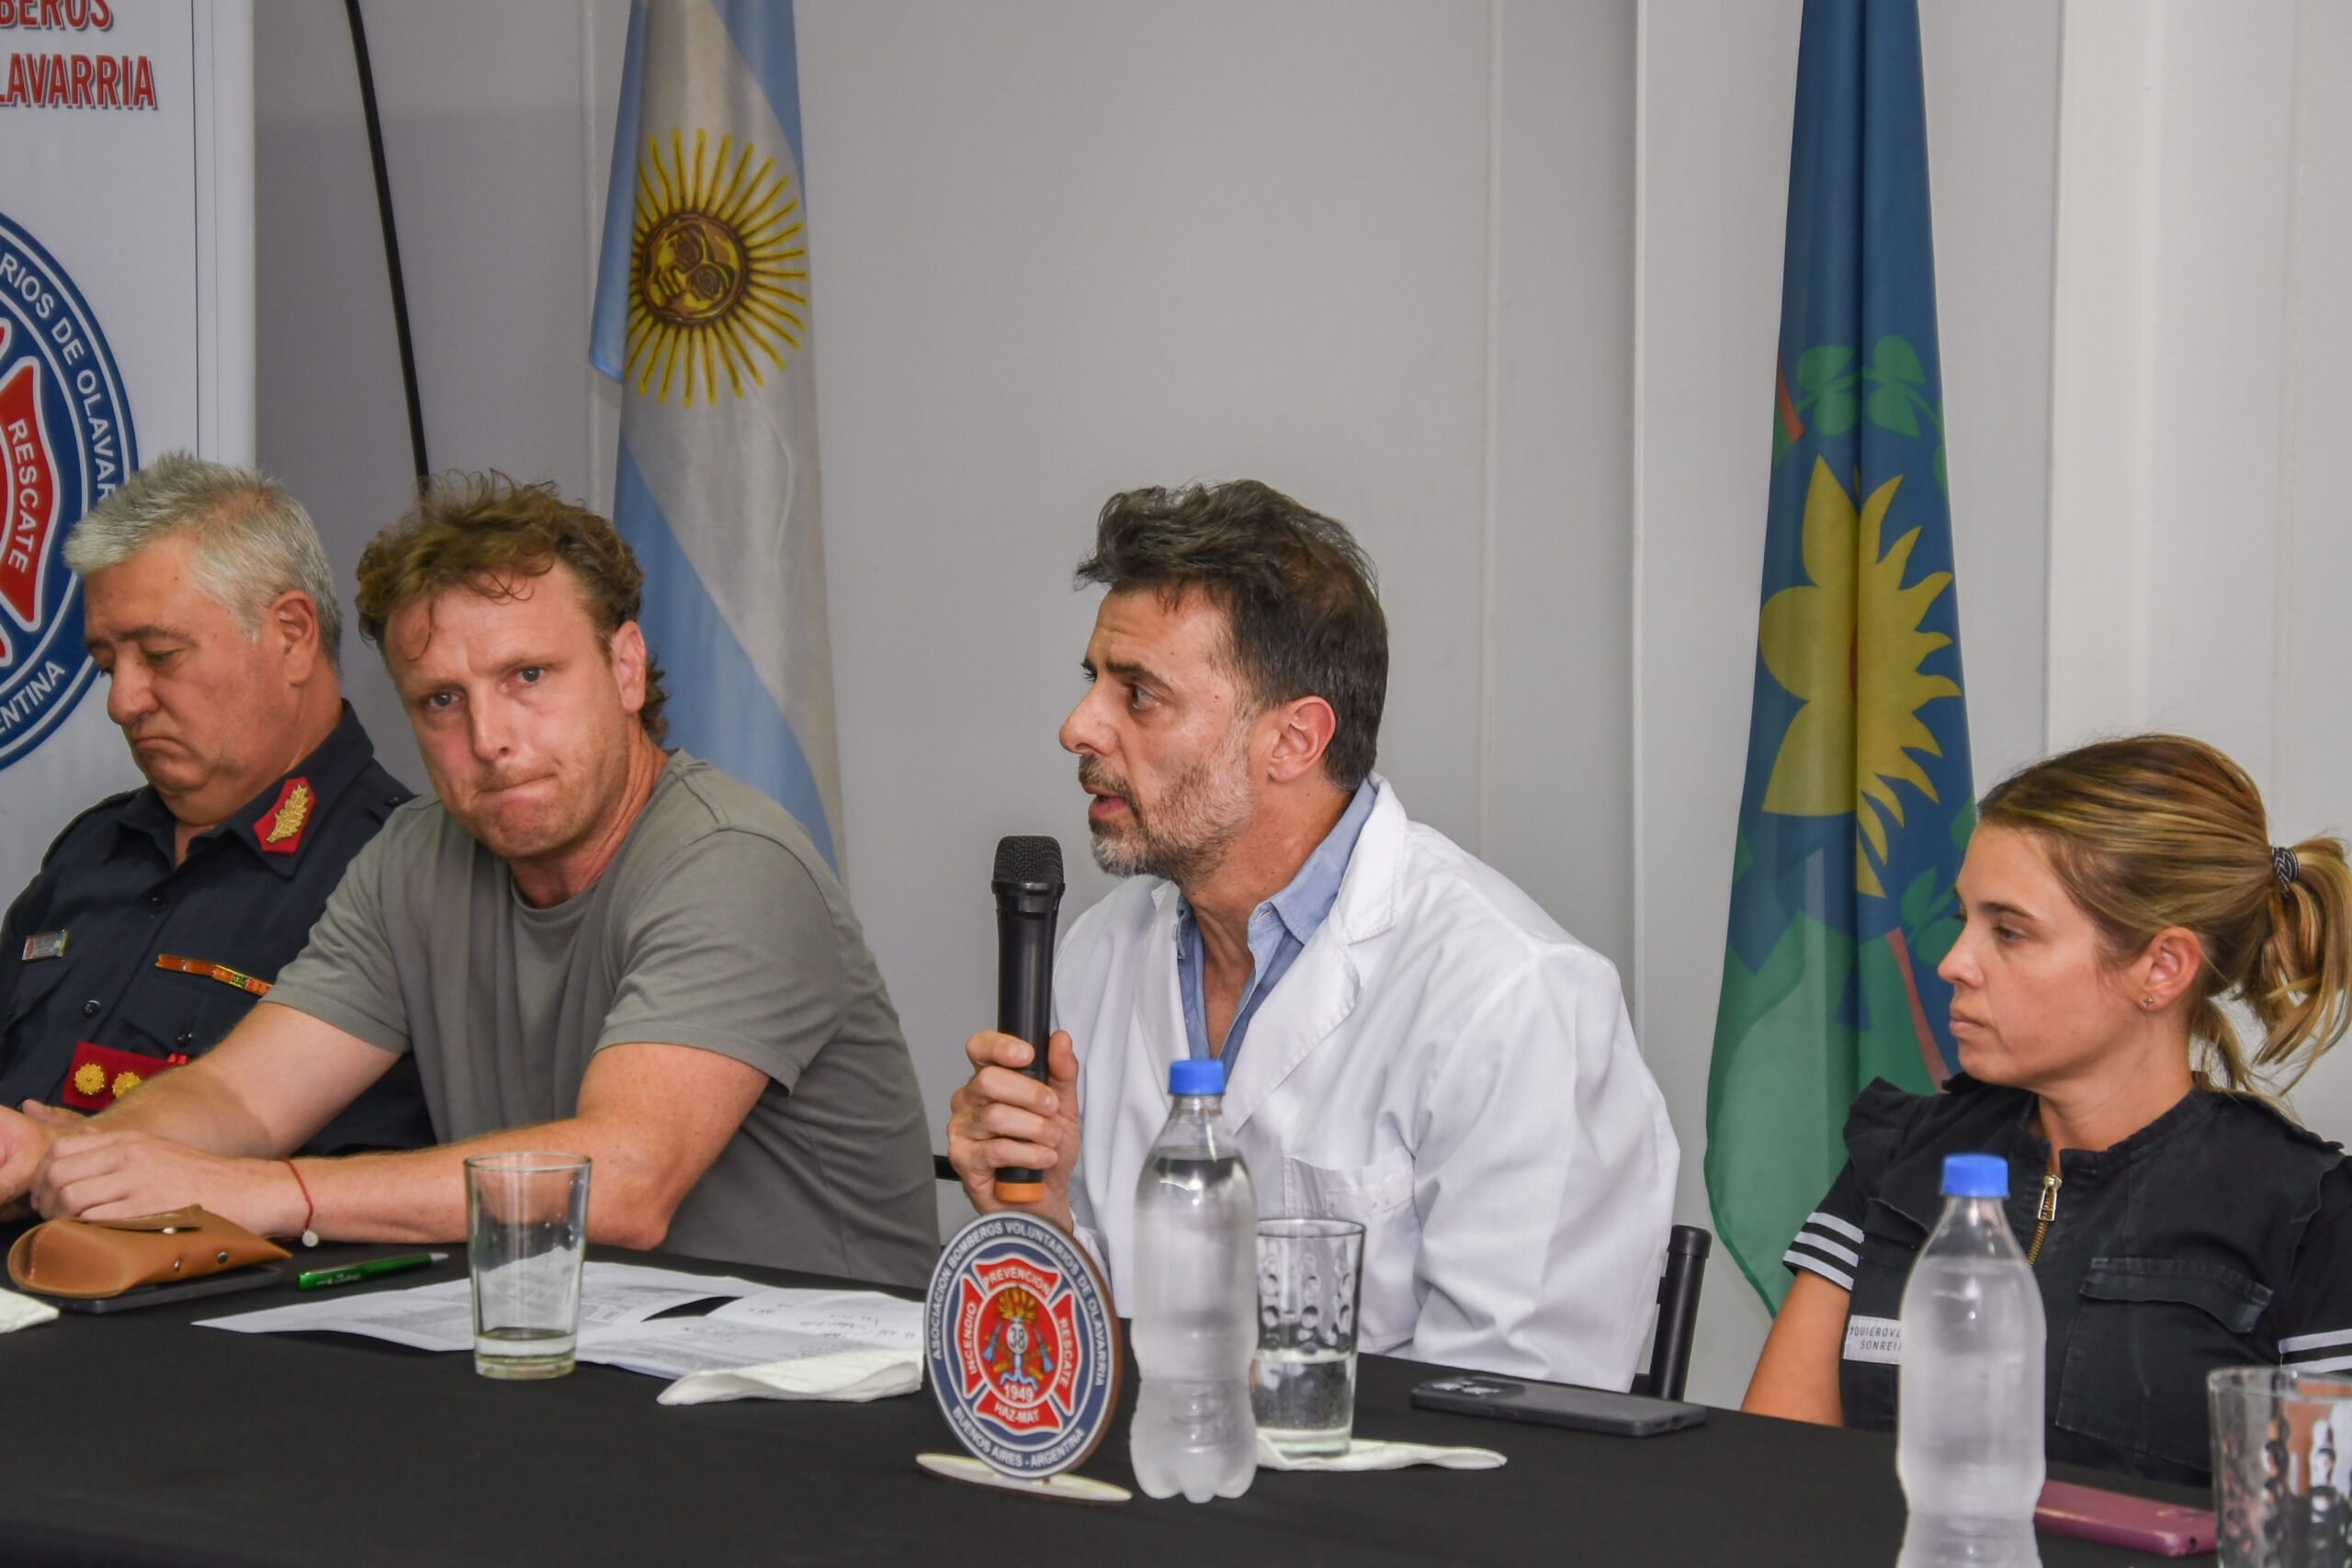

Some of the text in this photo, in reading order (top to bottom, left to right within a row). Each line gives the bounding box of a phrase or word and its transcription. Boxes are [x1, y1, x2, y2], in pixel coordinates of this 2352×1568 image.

[0, 52, 157, 109] AVARRIA
[51, 317, 85, 366] DE
[7, 418, 39, 574] RESCATE
[0, 660, 65, 734] NTINA
[931, 1221, 1108, 1386] ASOCIACION BOMBEROS VOLUNTARIOS DE OLAVARRIA
[982, 1267, 1050, 1295] PREVENCION
[964, 1303, 978, 1376] INCENDIO
[1010, 1327, 1025, 1349] 38
[1058, 1317, 1075, 1388] RESCATE
[1004, 1384, 1034, 1402] 1949
[953, 1406, 1085, 1467] BUENOS AIRES ARGENTINA
